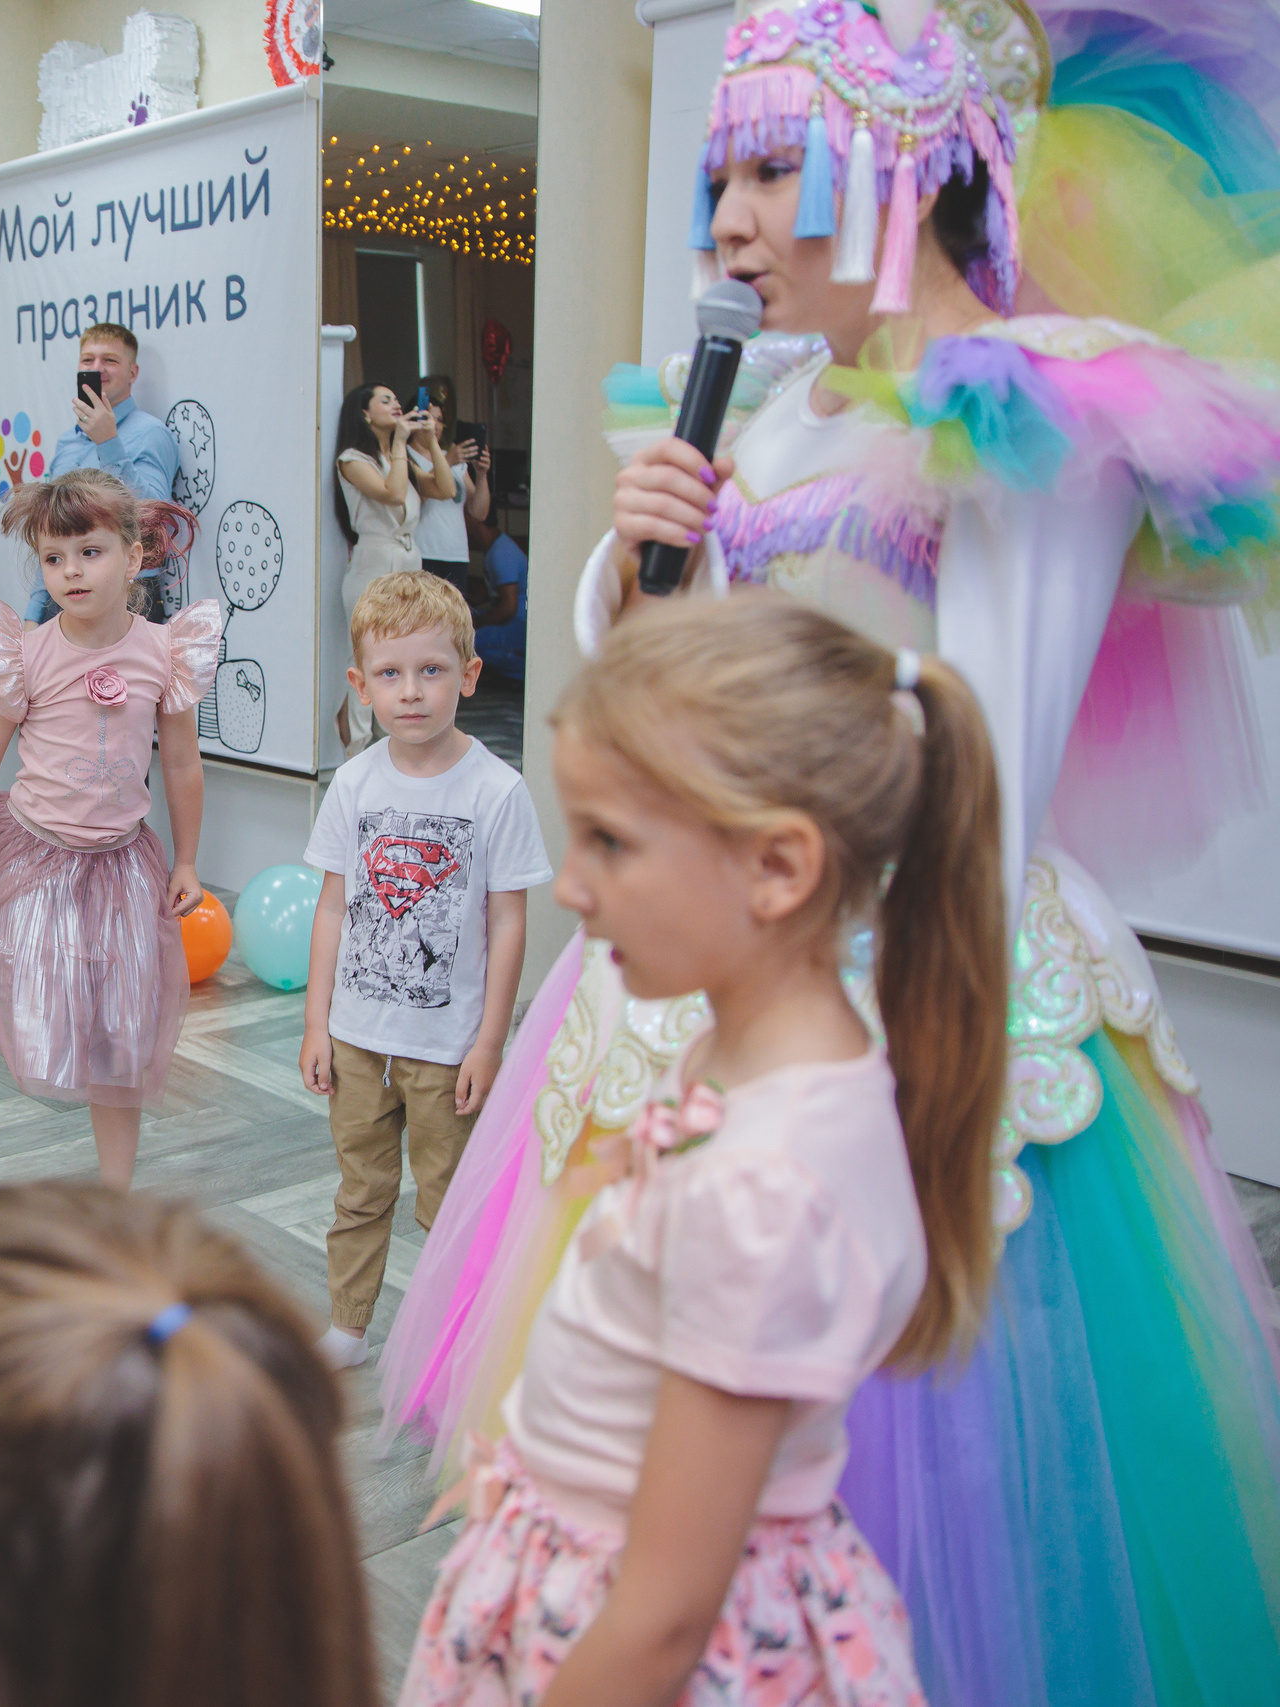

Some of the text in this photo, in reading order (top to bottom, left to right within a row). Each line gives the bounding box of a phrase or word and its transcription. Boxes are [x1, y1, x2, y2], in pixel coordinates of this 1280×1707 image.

[91, 145, 270, 262] лучший
[17, 274, 247, 361] праздник в
